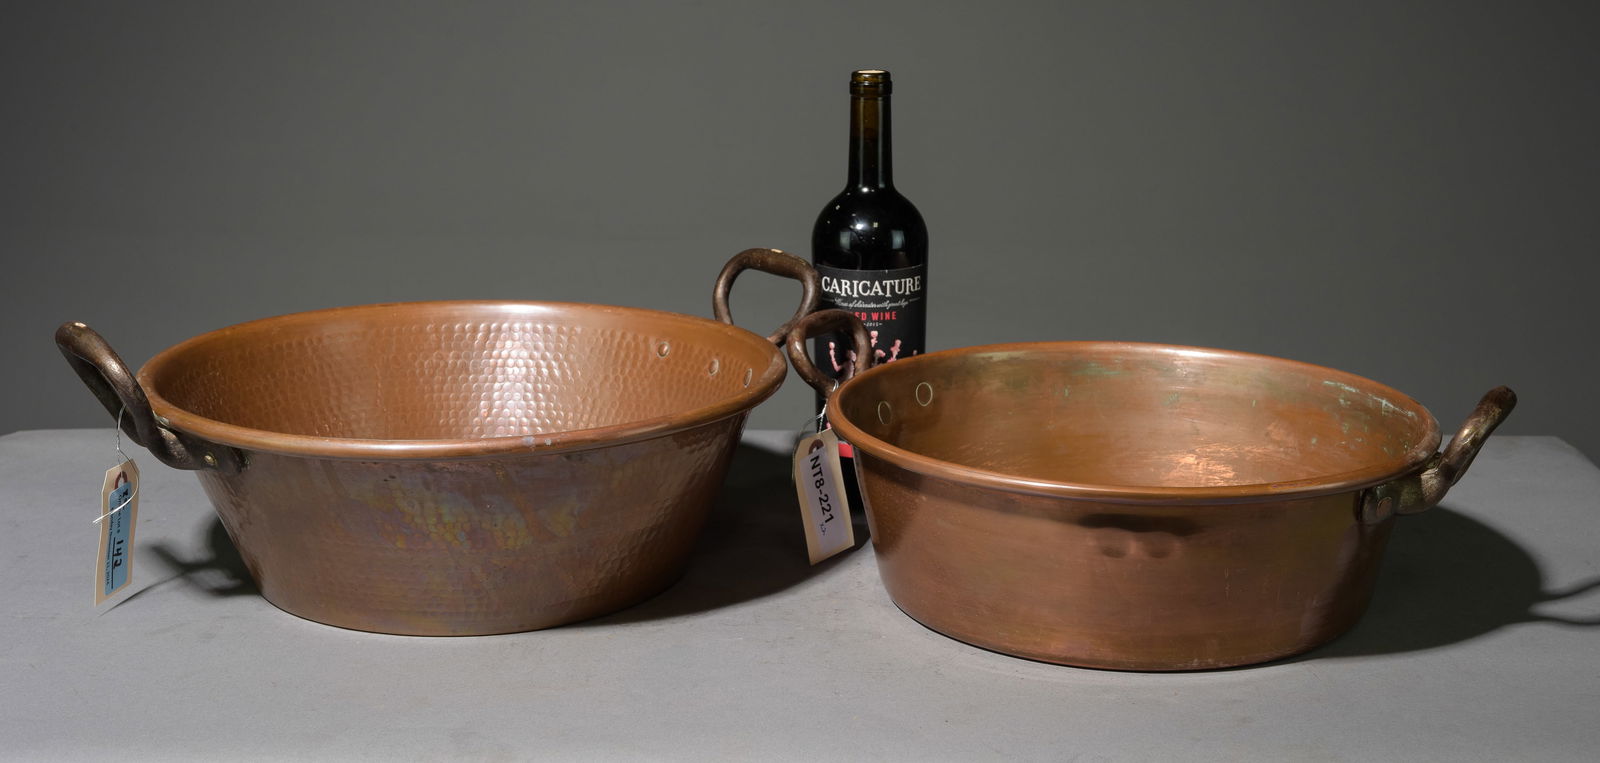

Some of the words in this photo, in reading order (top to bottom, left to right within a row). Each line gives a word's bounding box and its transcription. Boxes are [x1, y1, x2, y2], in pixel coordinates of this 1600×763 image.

[821, 275, 921, 298] CARICATURE
[871, 311, 897, 321] WINE
[809, 455, 835, 524] NT8-221
[112, 539, 124, 570] 142
